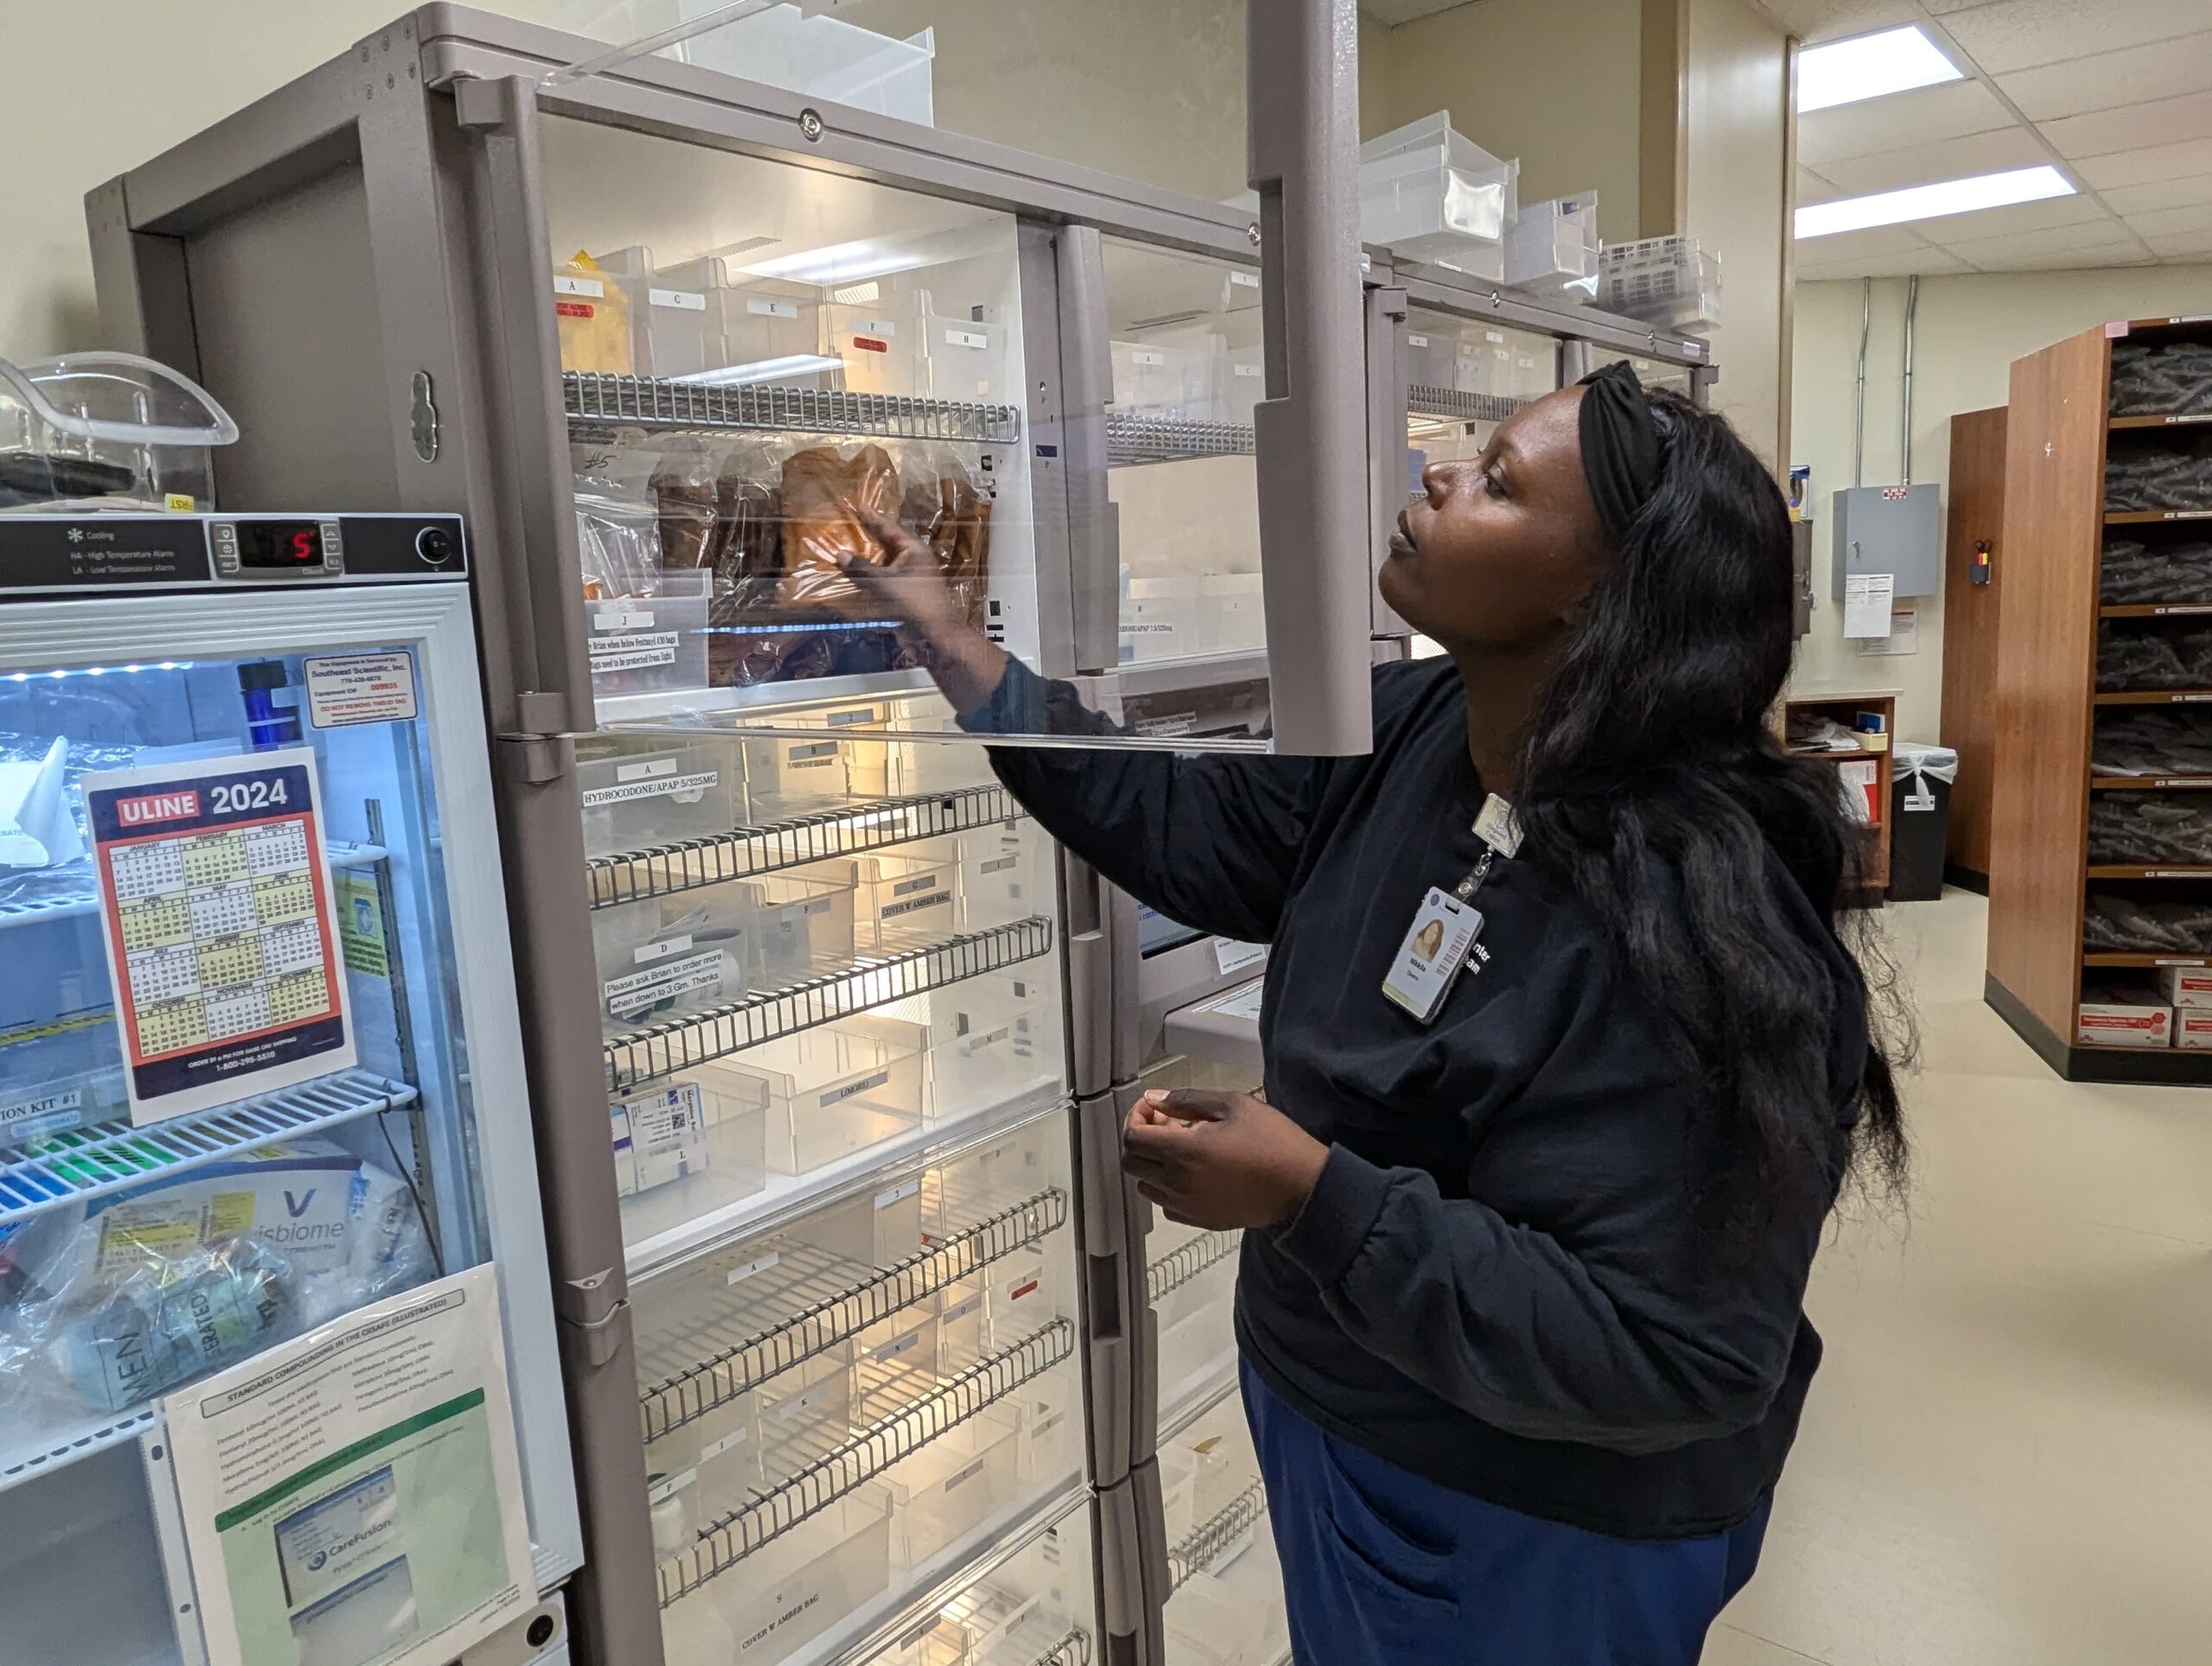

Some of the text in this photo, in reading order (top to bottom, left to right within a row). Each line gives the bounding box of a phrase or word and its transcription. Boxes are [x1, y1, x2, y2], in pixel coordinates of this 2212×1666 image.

[569, 281, 576, 290] A
[675, 295, 682, 304] C
[770, 303, 776, 312] E
[870, 322, 875, 331] F
[584, 452, 618, 469] #5
[86, 531, 115, 541] Cooling
[293, 531, 310, 559] 5
[87, 551, 105, 561] High
[105, 550, 152, 561] Temperature
[153, 550, 175, 558] Alarm
[89, 565, 105, 574] Low
[105, 564, 153, 574] Temperature
[154, 563, 175, 572] Alarm
[621, 616, 627, 626] J
[593, 639, 607, 649] Brian
[607, 639, 620, 647] when
[620, 638, 635, 647] below
[635, 636, 657, 647] Fentanyl
[665, 635, 677, 646] bags
[602, 658, 613, 668] need
[613, 658, 620, 666] to
[620, 657, 626, 665] be
[626, 653, 648, 667] protected
[648, 653, 660, 663] from
[660, 652, 672, 663] light
[312, 663, 407, 678] Southeast Scientific, Inc.
[314, 689, 346, 697] Equipment
[345, 702, 372, 710] REMOVE
[810, 746, 817, 755] B
[644, 766, 652, 774] A
[584, 774, 716, 804] HYDROCODONE/APAP 5/325MG
[123, 779, 288, 822] ULINE 2024
[262, 823, 286, 831] MARCH
[196, 832, 227, 842] FEBRUARY
[130, 842, 161, 852] JANUARY
[881, 892, 950, 917] COVER W AMBER BAG
[272, 919, 305, 932] SEPTEMBER
[215, 932, 240, 943] AUGUST
[279, 969, 312, 981] DECEMBER
[607, 953, 722, 993] Please ask Brian to order more
[216, 982, 253, 995] NOVEMBER
[611, 971, 719, 1010] when down to 3 Gm. Thanks
[152, 996, 186, 1008] OCTOBER
[188, 1059, 209, 1068] ORDER
[215, 1050, 276, 1071] 1-800-295-5510
[30, 1097, 56, 1114] KIT
[62, 1093, 76, 1105] #1
[679, 1150, 687, 1160] L
[283, 1187, 317, 1218] V
[750, 1263, 757, 1273] A
[227, 1375, 274, 1402] STANDARD
[274, 1345, 335, 1381] COMPOUNDING
[334, 1339, 345, 1349] IN
[345, 1332, 361, 1345] THE
[391, 1298, 448, 1326] (ILLUSTRATED)
[353, 1360, 386, 1377] Methadone
[418, 1340, 435, 1351] ORAL
[353, 1374, 383, 1389] Morphine
[416, 1354, 432, 1364] ORAL
[306, 1389, 318, 1399] BAG
[329, 1519, 392, 1557] CareFusion
[776, 1593, 783, 1604] S
[741, 1593, 820, 1651] COVER W AMBER BAG
